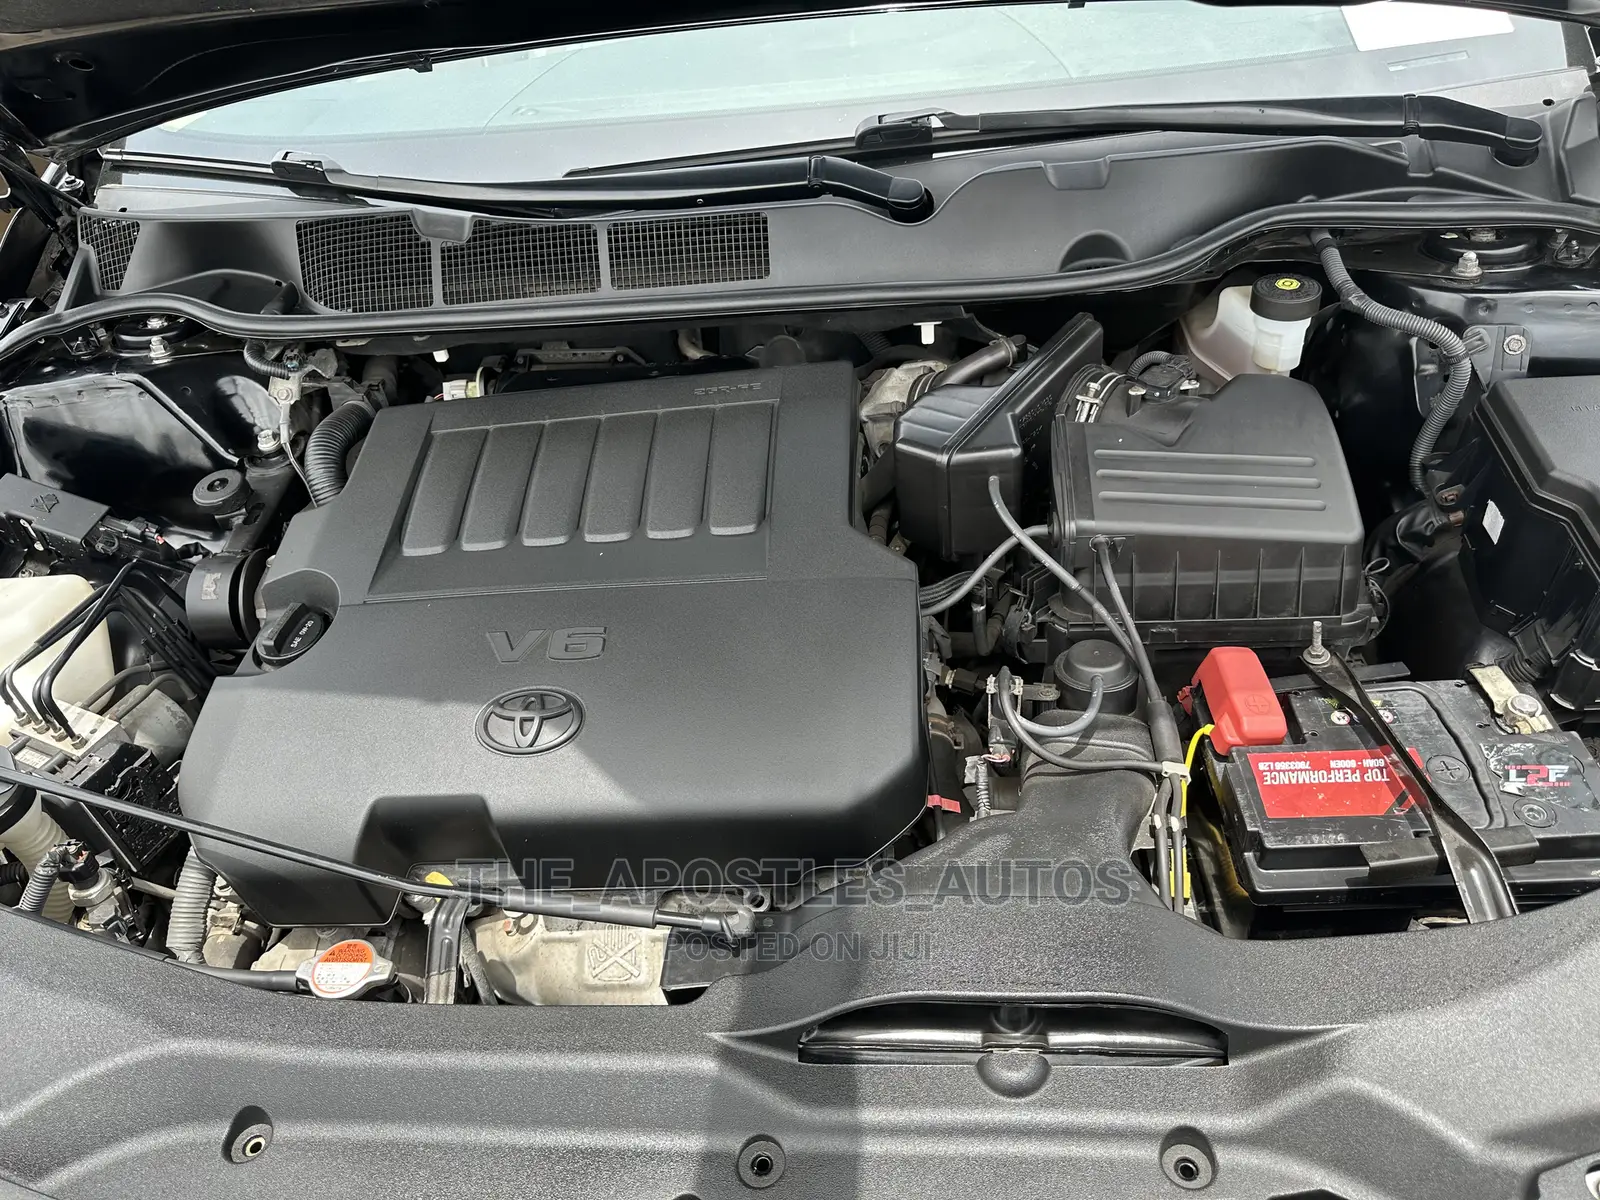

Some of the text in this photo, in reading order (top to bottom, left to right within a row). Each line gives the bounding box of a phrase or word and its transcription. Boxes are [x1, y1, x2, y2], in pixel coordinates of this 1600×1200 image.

[486, 626, 608, 664] V6
[1363, 758, 1385, 768] 60AH
[1263, 768, 1390, 785] TOP PERFORMANCE
